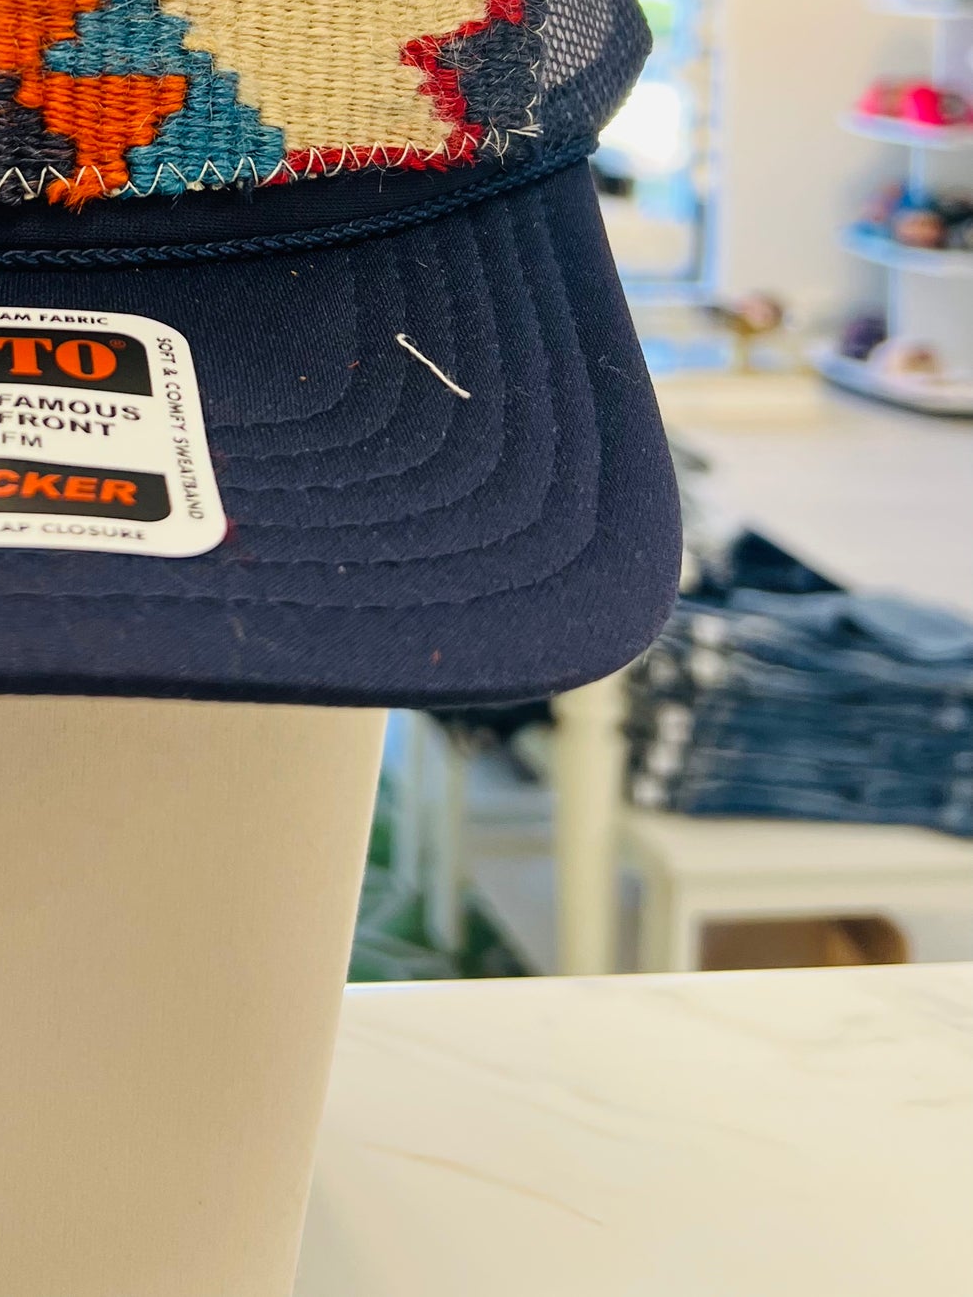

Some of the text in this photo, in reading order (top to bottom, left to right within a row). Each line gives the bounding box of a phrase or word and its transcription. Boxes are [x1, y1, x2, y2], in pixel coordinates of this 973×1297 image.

[40, 315, 108, 325] FABRIC
[156, 337, 204, 520] SOFT & COMFY SWEATBAND
[41, 525, 147, 540] CLOSURE
